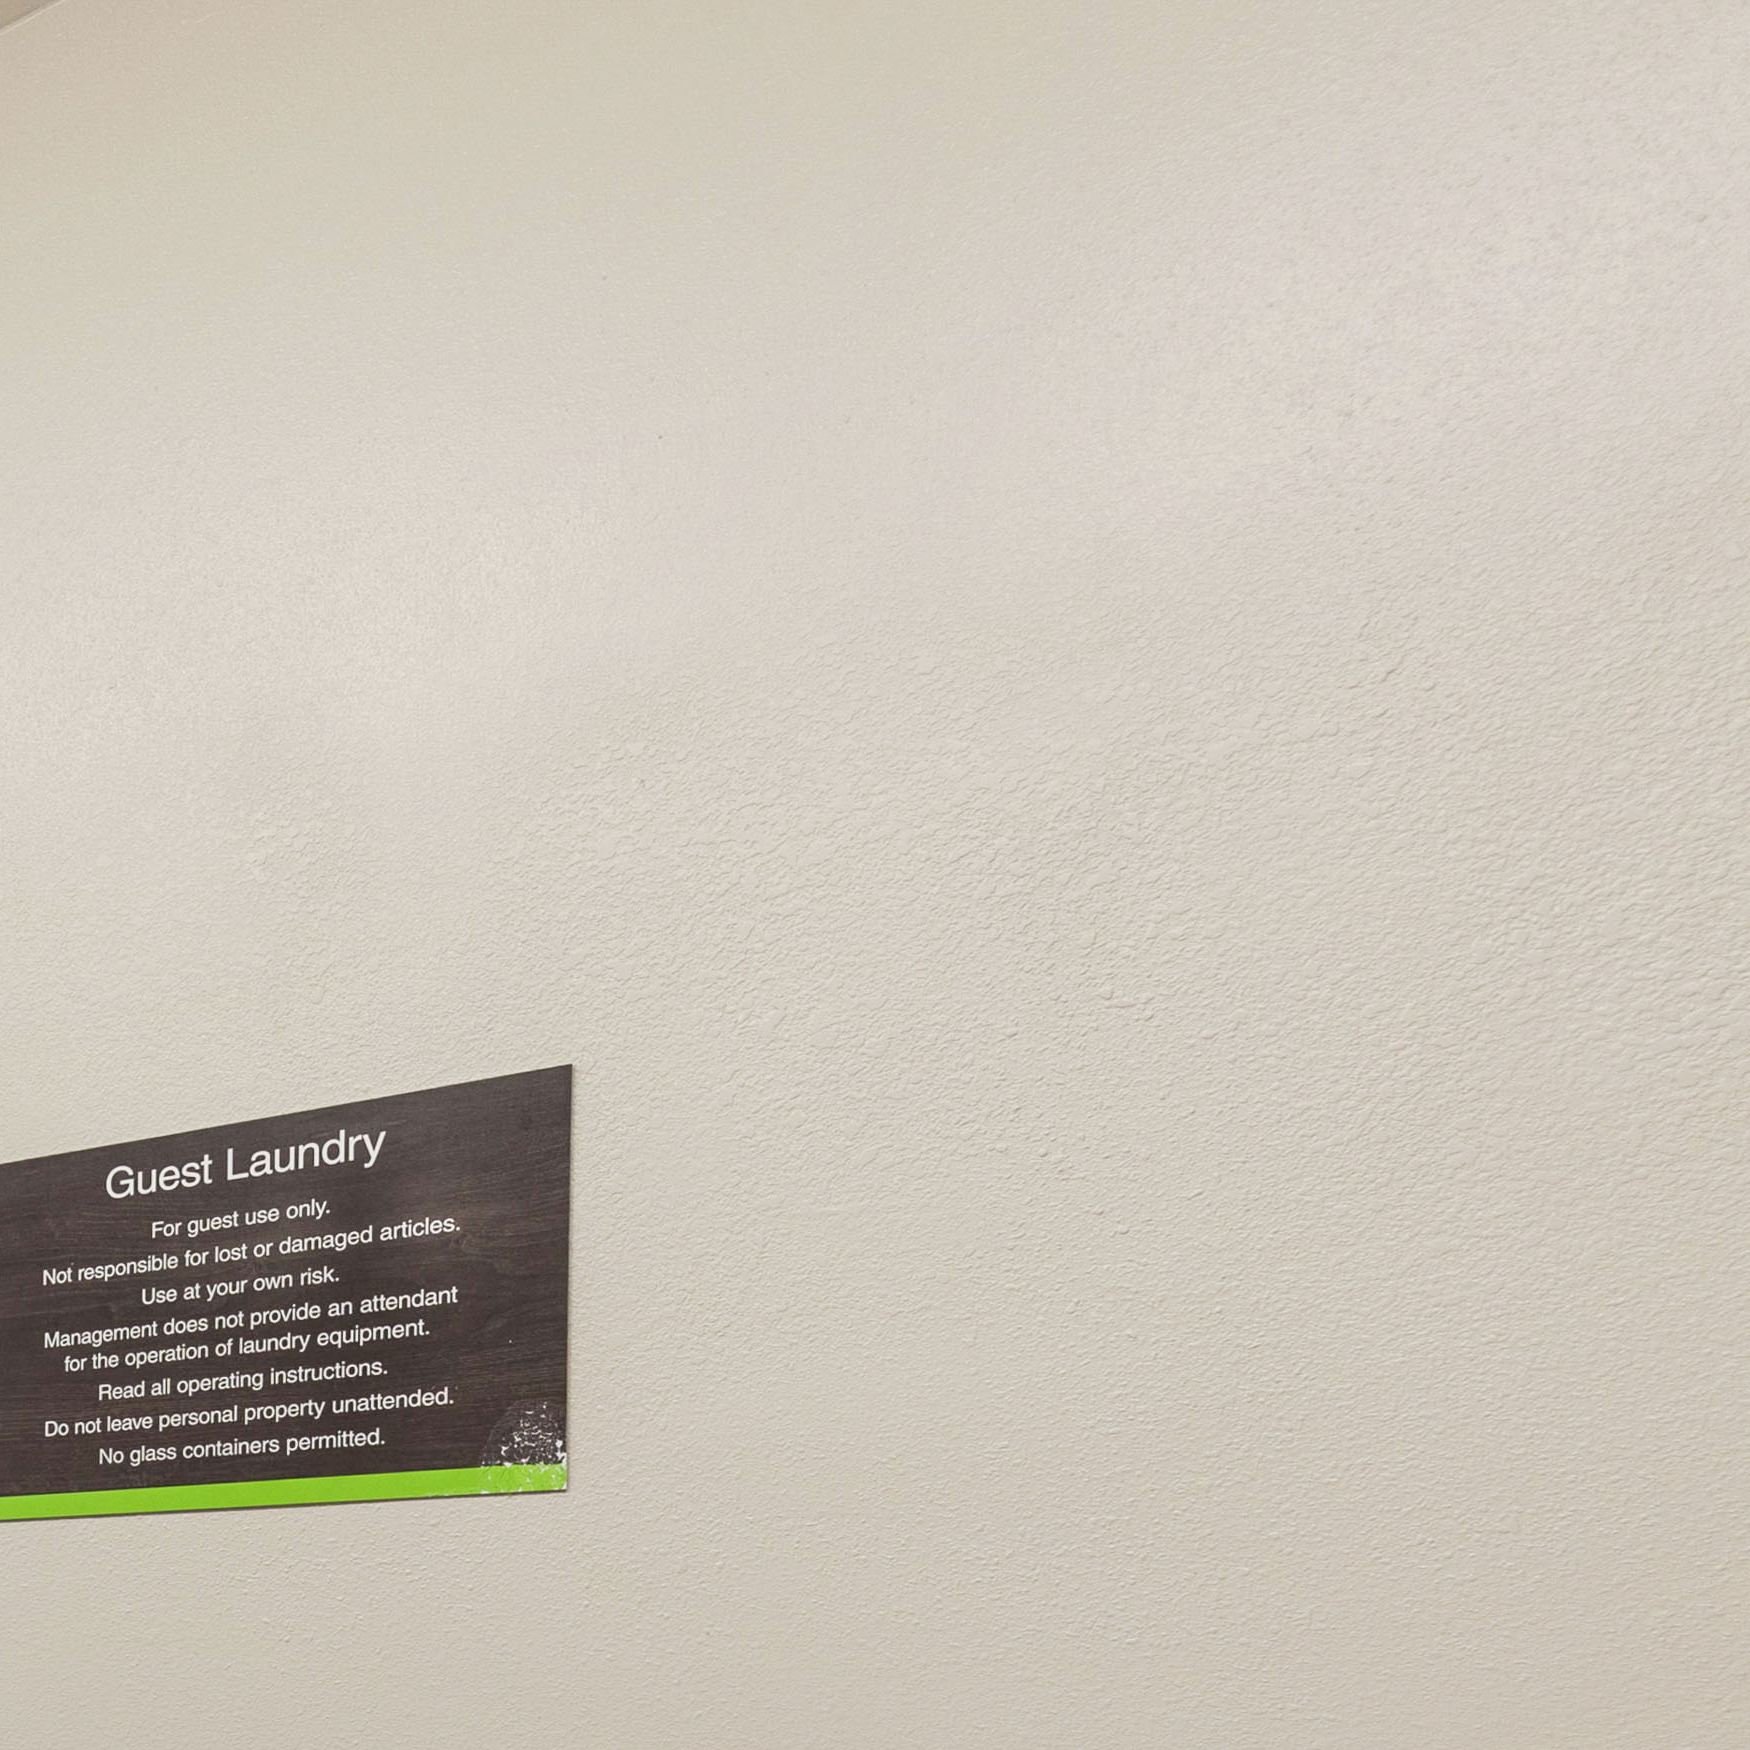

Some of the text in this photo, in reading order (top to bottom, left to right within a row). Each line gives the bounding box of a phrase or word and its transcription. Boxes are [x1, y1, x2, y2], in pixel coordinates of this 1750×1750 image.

[105, 1128, 387, 1200] Guest Laundry
[151, 1198, 331, 1239] For guest use only.
[42, 1216, 461, 1286] Not responsible for lost or damaged articles.
[141, 1265, 340, 1306] Use at your own risk.
[44, 1285, 459, 1349] Management does not provide an attendant
[64, 1318, 430, 1372] for the operation of laundry equipment.
[98, 1360, 388, 1402] Read all operating instructions.
[44, 1386, 454, 1438] Do not leave personal property unattended.
[98, 1426, 386, 1468] No glass containers permitted.
